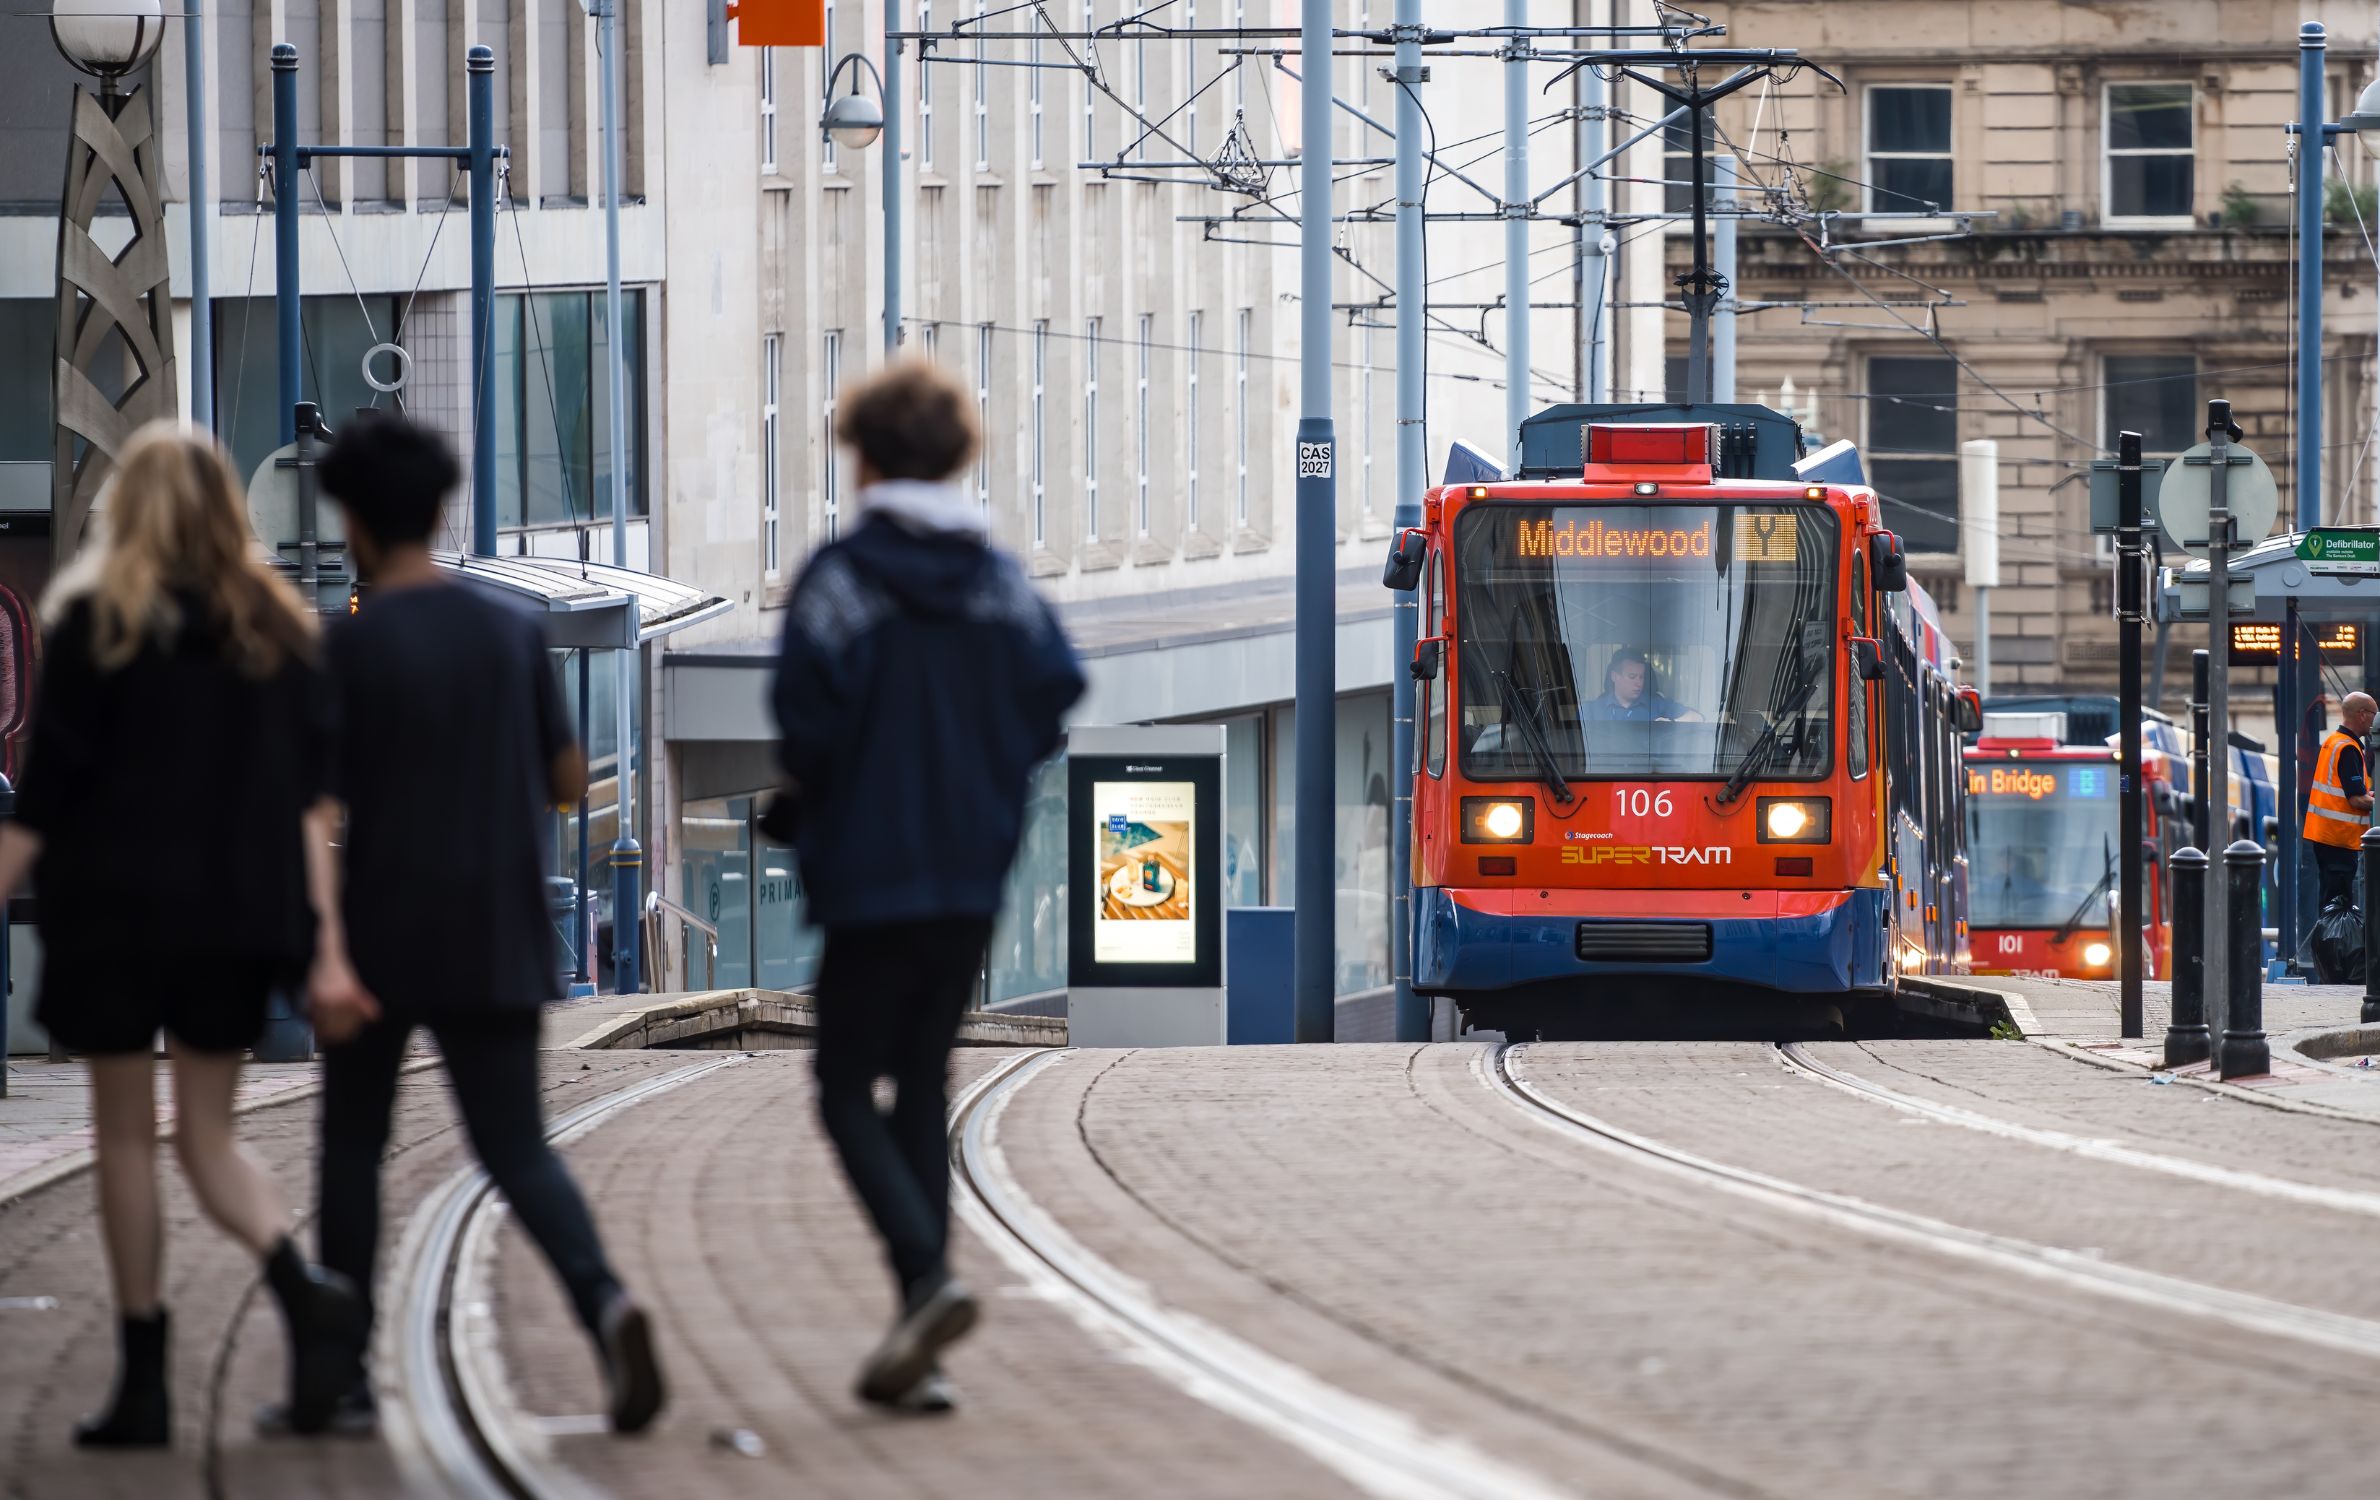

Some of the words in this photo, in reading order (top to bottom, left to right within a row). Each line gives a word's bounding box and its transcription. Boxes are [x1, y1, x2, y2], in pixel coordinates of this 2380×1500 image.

[1301, 447, 1330, 460] CAS
[1301, 461, 1330, 473] 2027
[1520, 520, 1709, 556] Middlewood
[1754, 515, 1776, 557] Y
[2326, 539, 2375, 549] Defibrillator
[1991, 768, 2057, 800] Bridge
[2079, 769, 2095, 795] B
[1616, 789, 1673, 817] 106
[1574, 831, 1613, 840] Stagecoach
[1561, 846, 1731, 865] SUPERTRAM
[760, 879, 807, 905] PRIMA
[1999, 935, 2022, 953] 101
